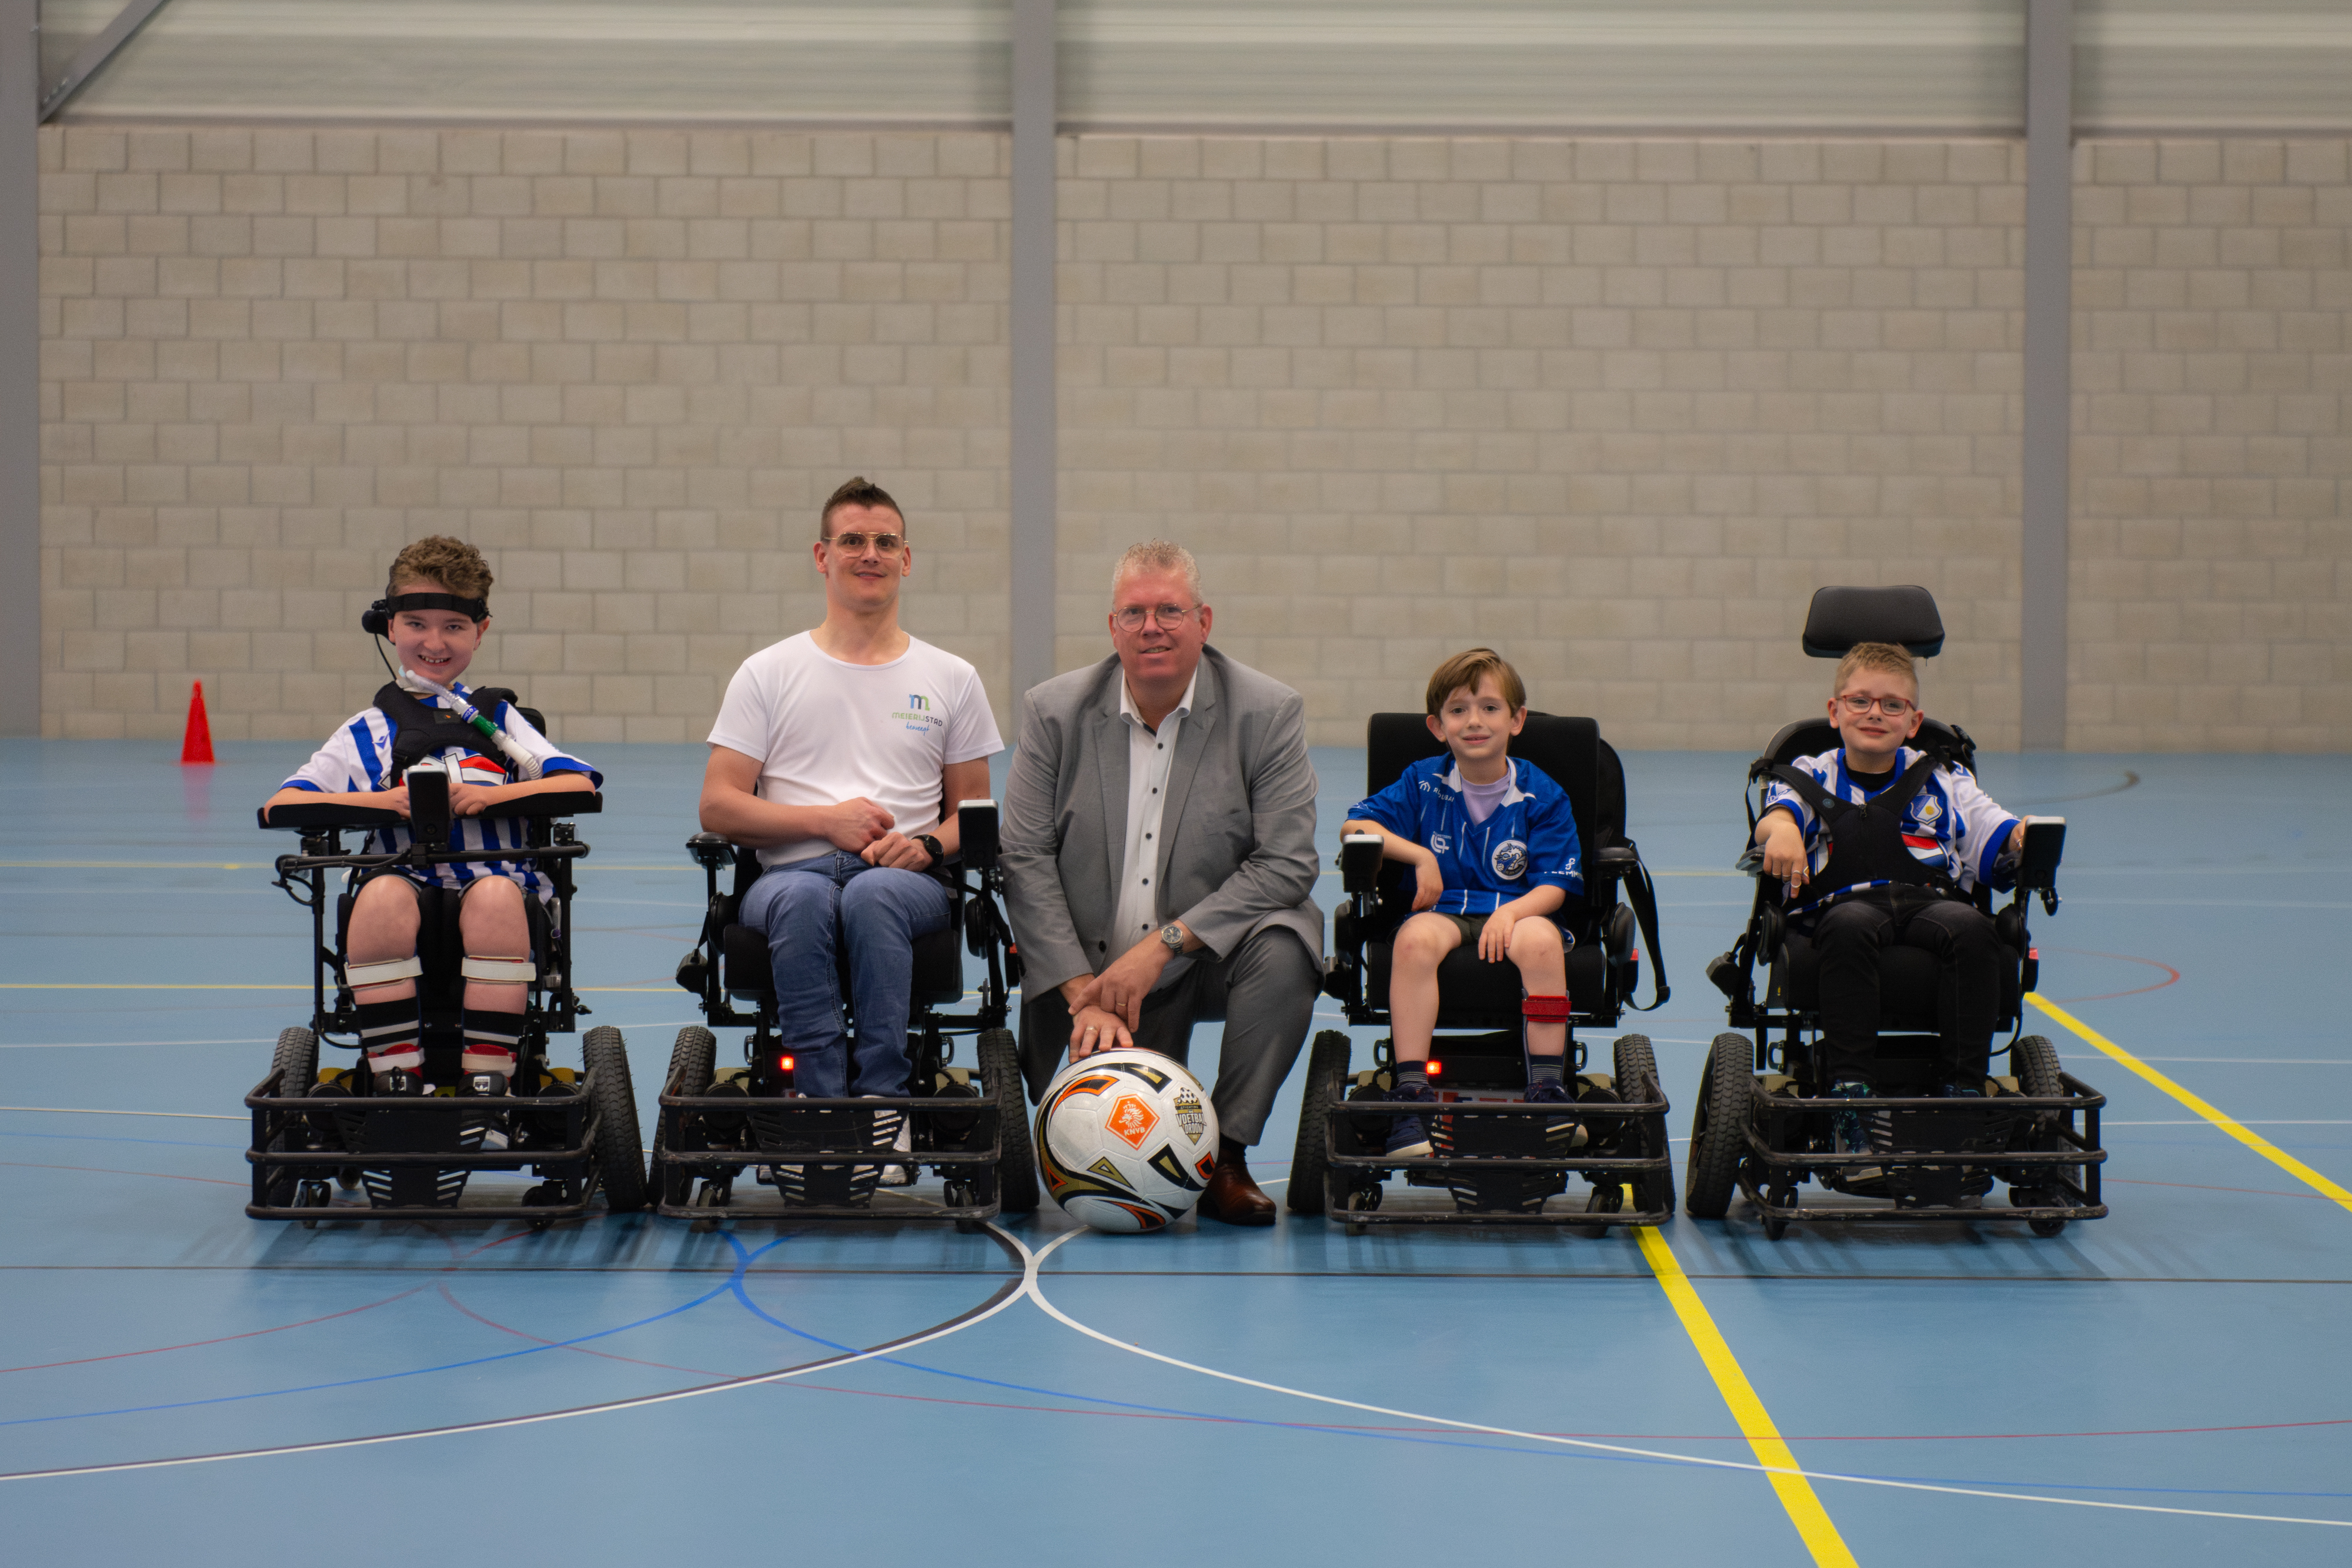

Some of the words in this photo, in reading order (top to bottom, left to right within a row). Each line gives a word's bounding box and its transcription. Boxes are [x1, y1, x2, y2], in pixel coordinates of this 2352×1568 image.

[892, 712, 943, 726] MEIERIJSTAD
[906, 721, 930, 736] beweegt
[1124, 1127, 1145, 1136] KNVB
[1184, 1123, 1203, 1134] DROOM
